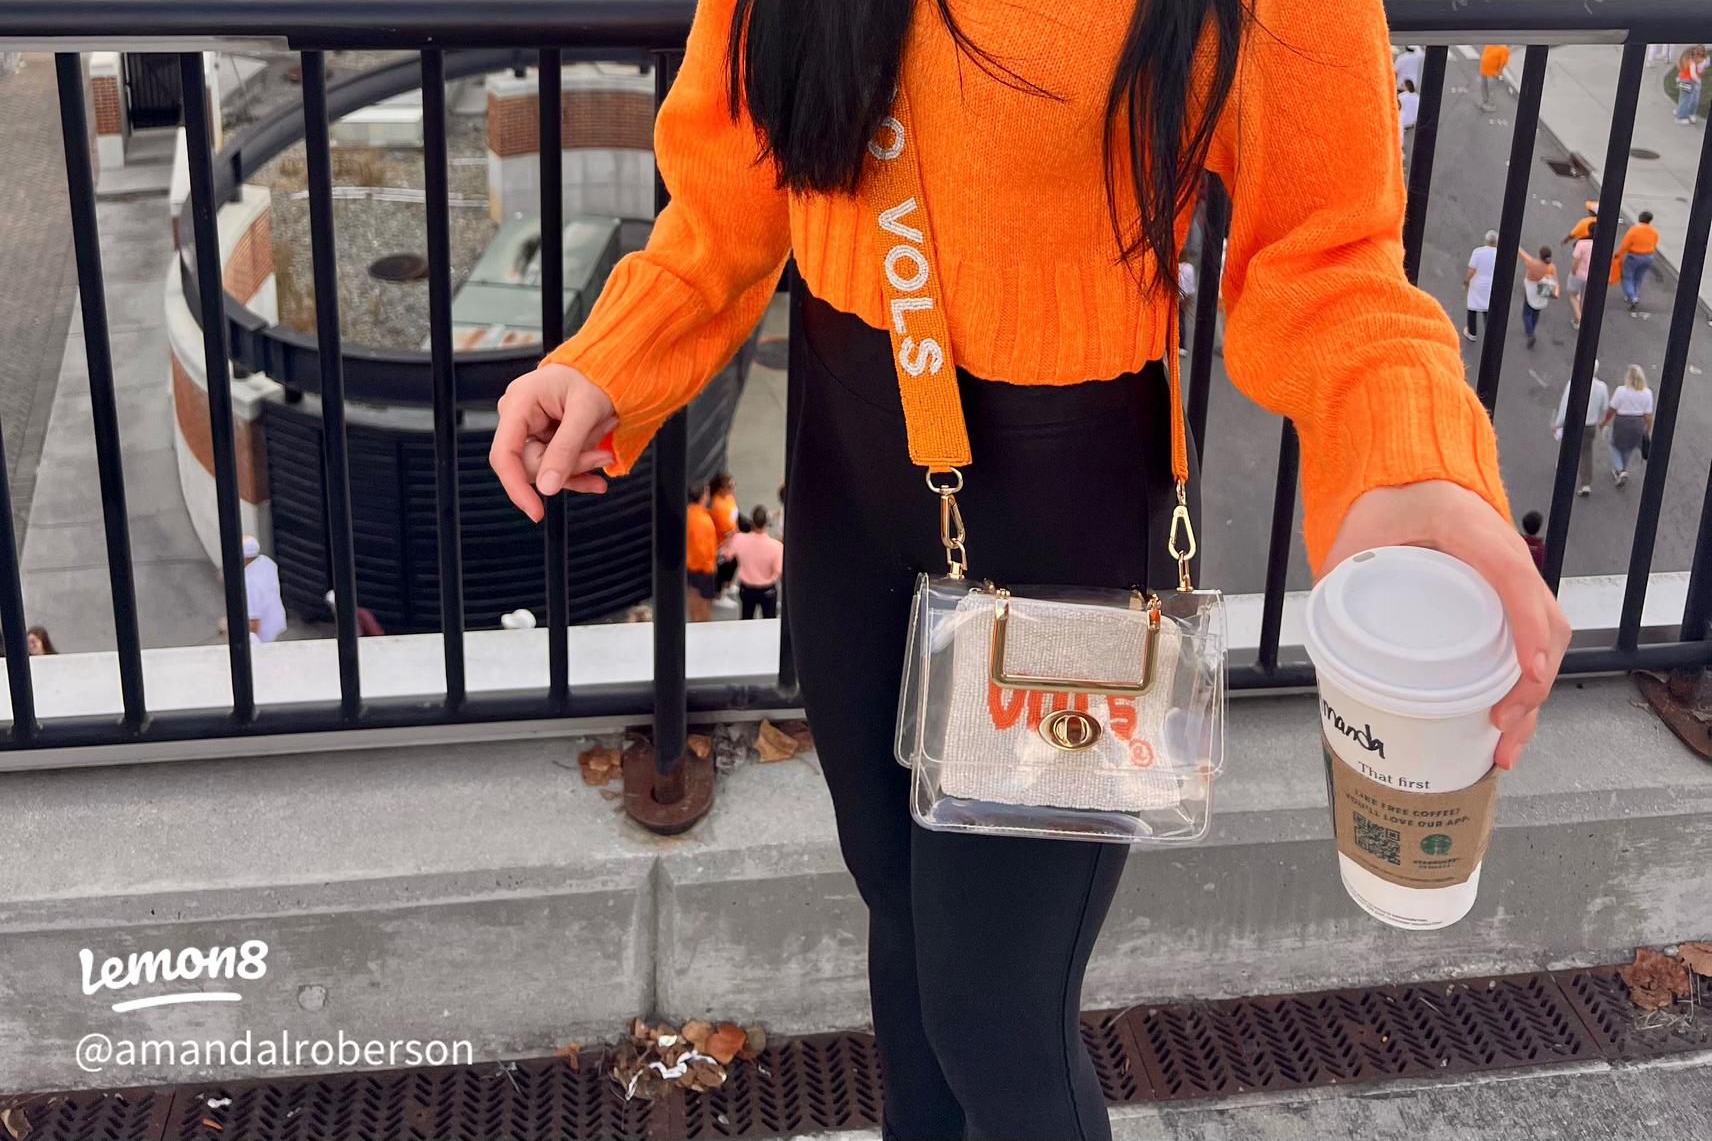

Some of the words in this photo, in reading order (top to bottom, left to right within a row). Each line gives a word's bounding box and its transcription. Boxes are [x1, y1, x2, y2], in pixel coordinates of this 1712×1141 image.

[878, 196, 944, 377] VOLS
[1357, 760, 1394, 785] That
[1398, 776, 1431, 790] first
[1384, 814, 1414, 827] LOVE
[1418, 819, 1443, 828] OUR
